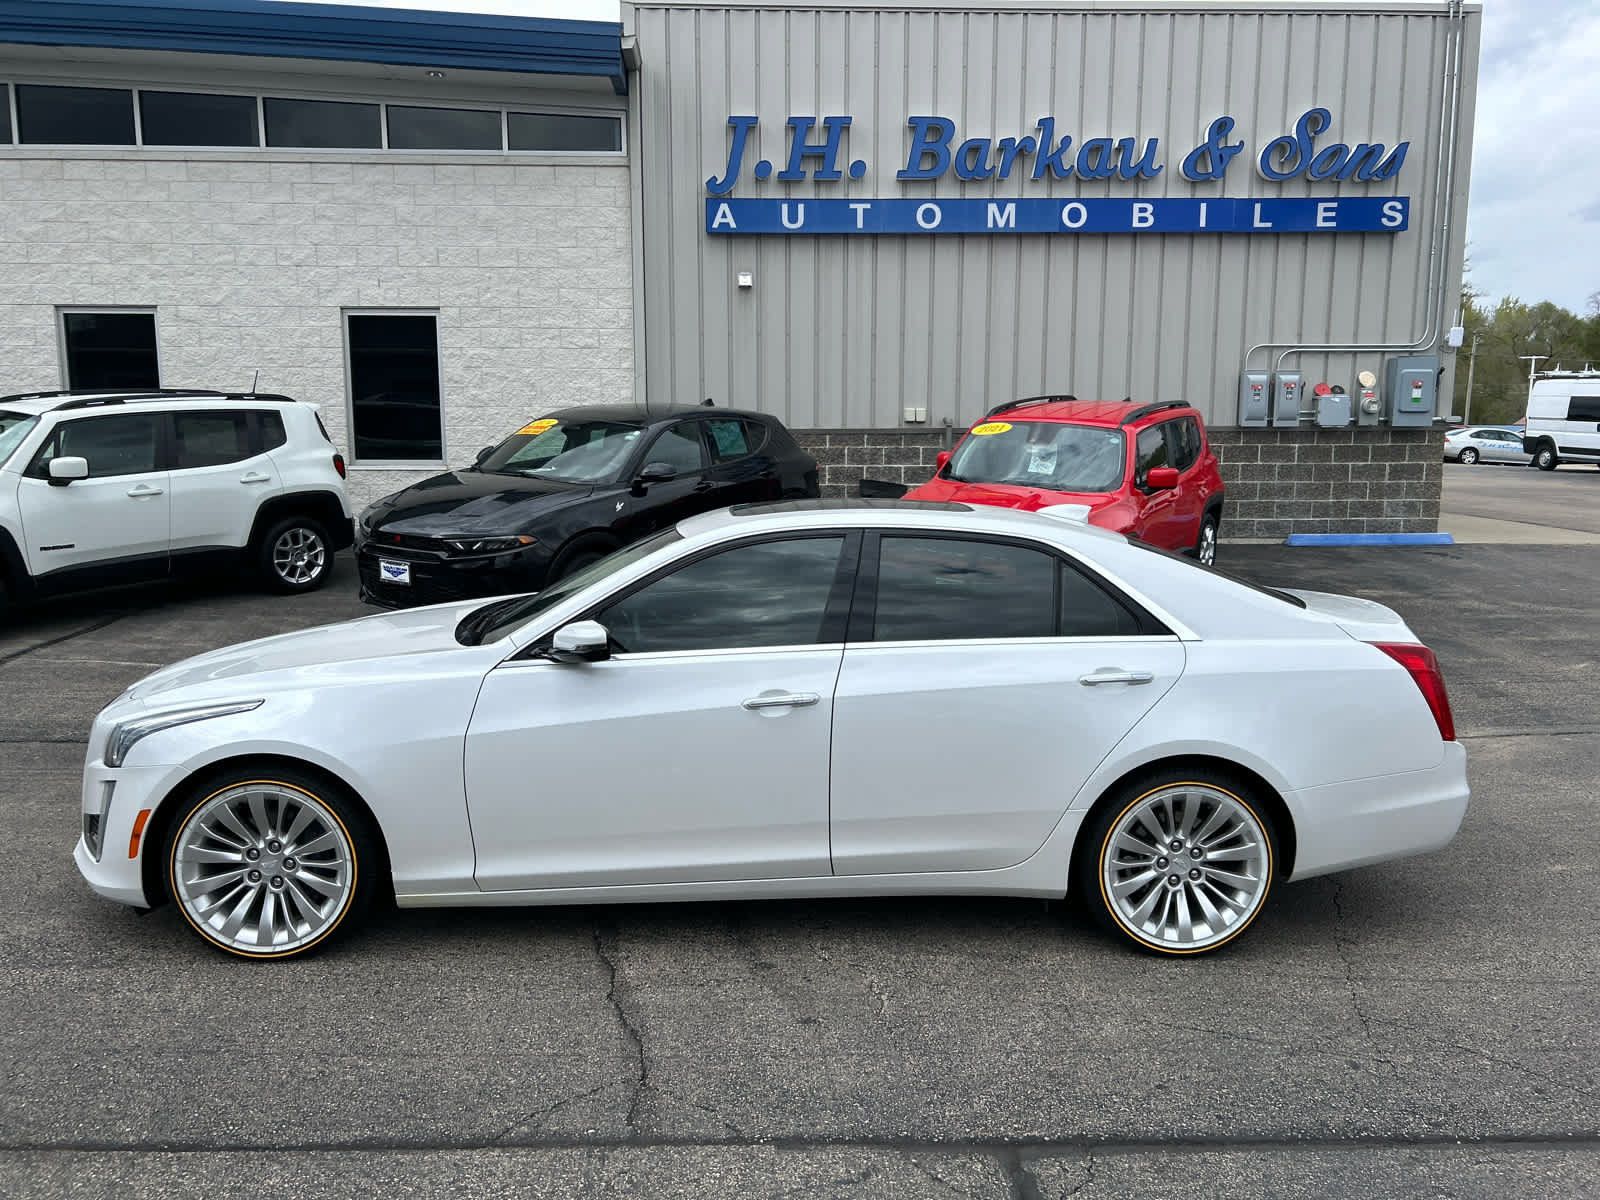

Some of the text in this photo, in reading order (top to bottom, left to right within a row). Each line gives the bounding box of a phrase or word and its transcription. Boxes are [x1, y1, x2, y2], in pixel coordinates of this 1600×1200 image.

[705, 107, 1410, 194] J.H. Barkau & Sons
[711, 200, 1404, 230] AUTOMOBILES
